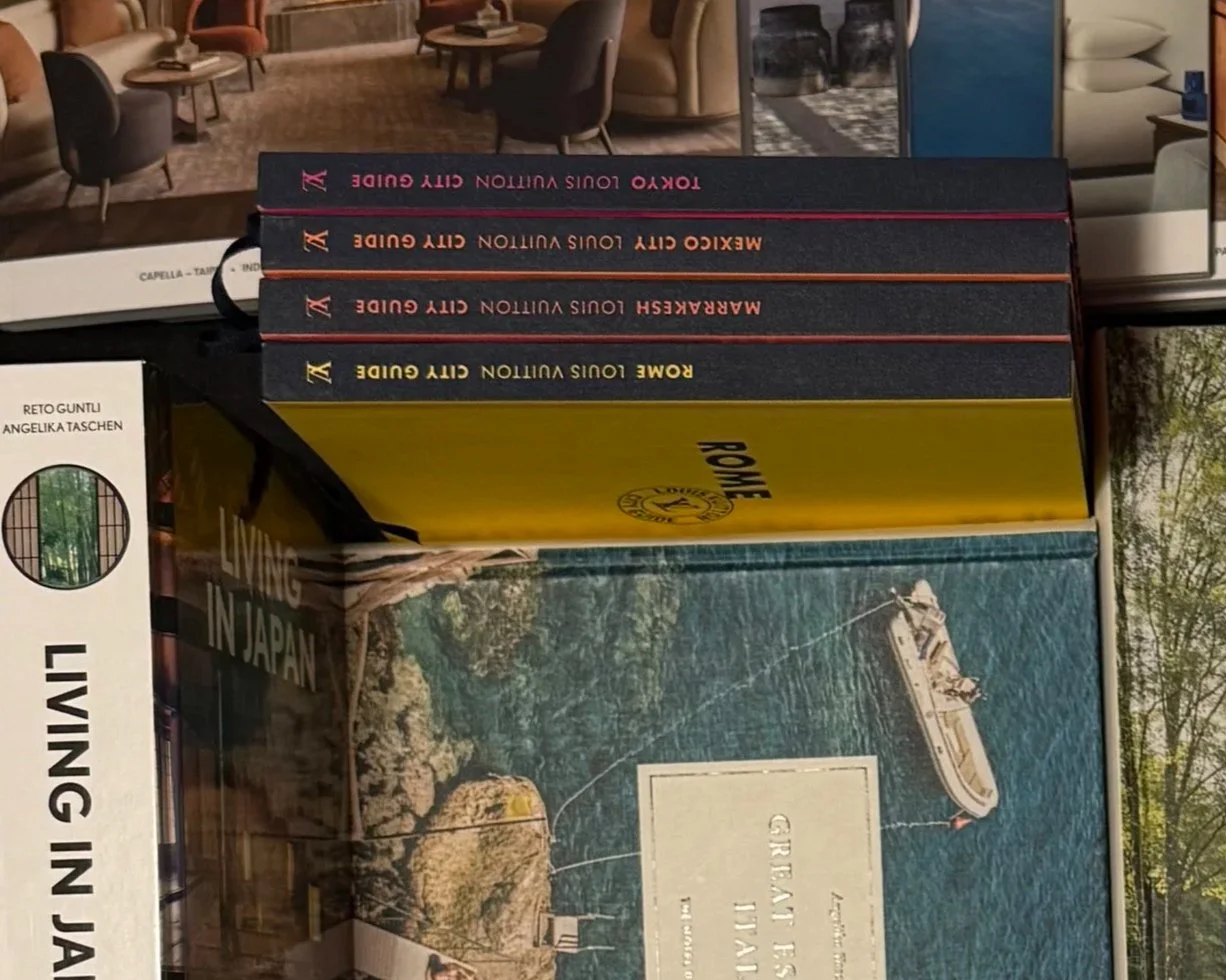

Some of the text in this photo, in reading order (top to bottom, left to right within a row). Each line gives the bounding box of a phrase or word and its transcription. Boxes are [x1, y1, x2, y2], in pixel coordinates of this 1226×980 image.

[352, 174, 701, 190] TOKYO LOUIS VUITTON CITY GUIDE
[354, 233, 763, 251] MEXICO CITY LOUIS VUITTON CITY GUIDE
[139, 269, 184, 282] CAPELLA
[356, 299, 762, 315] MARRAKESH LOUIS VUITTON CITY GUIDE
[357, 364, 694, 380] ROME LOUIS VUITTON CITY GUIDE
[23, 401, 102, 416] RETO GUNTLI
[2, 419, 123, 434] ANGELIKA TASCHEN
[696, 441, 772, 499] ROME
[218, 505, 302, 610] LIVING
[206, 580, 318, 693] IN JAPAN
[44, 643, 93, 824] LIVING
[49, 841, 95, 896] IN
[768, 812, 795, 927] GREAT
